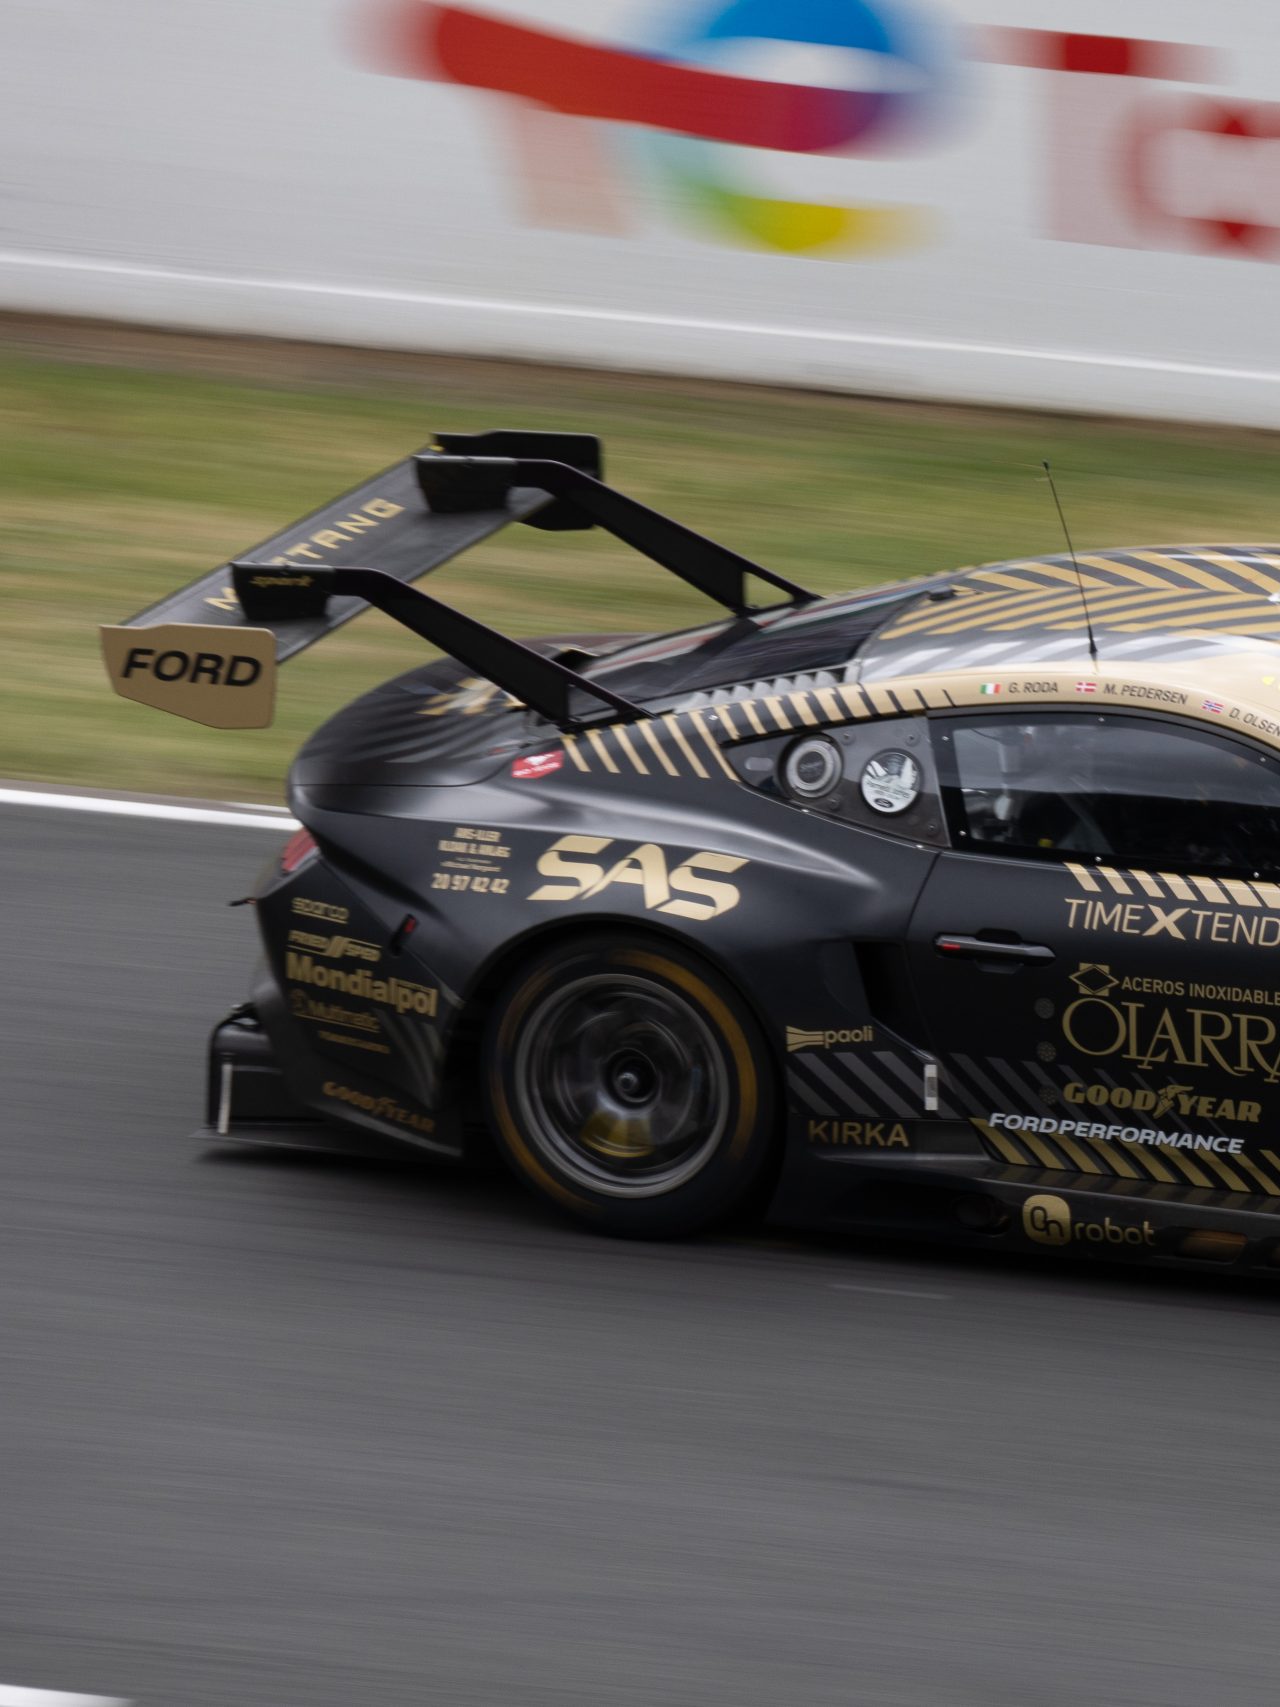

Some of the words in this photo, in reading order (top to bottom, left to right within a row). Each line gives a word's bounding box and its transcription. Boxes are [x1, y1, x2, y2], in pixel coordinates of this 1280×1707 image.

[203, 498, 406, 611] MTANG
[121, 648, 262, 687] FORD
[1008, 682, 1021, 693] G.
[1023, 682, 1059, 693] RODA
[1103, 683, 1118, 696] M.
[1121, 685, 1189, 705] PEDERSEN
[1228, 707, 1241, 720] D.
[526, 834, 750, 921] SAS
[286, 952, 439, 1017] Mondialpol
[1122, 976, 1185, 996] ACEROS
[824, 1026, 874, 1049] paoli
[1063, 1083, 1262, 1122] GOODYEAR
[808, 1120, 910, 1148] KIRKA
[1074, 1218, 1155, 1247] robot
